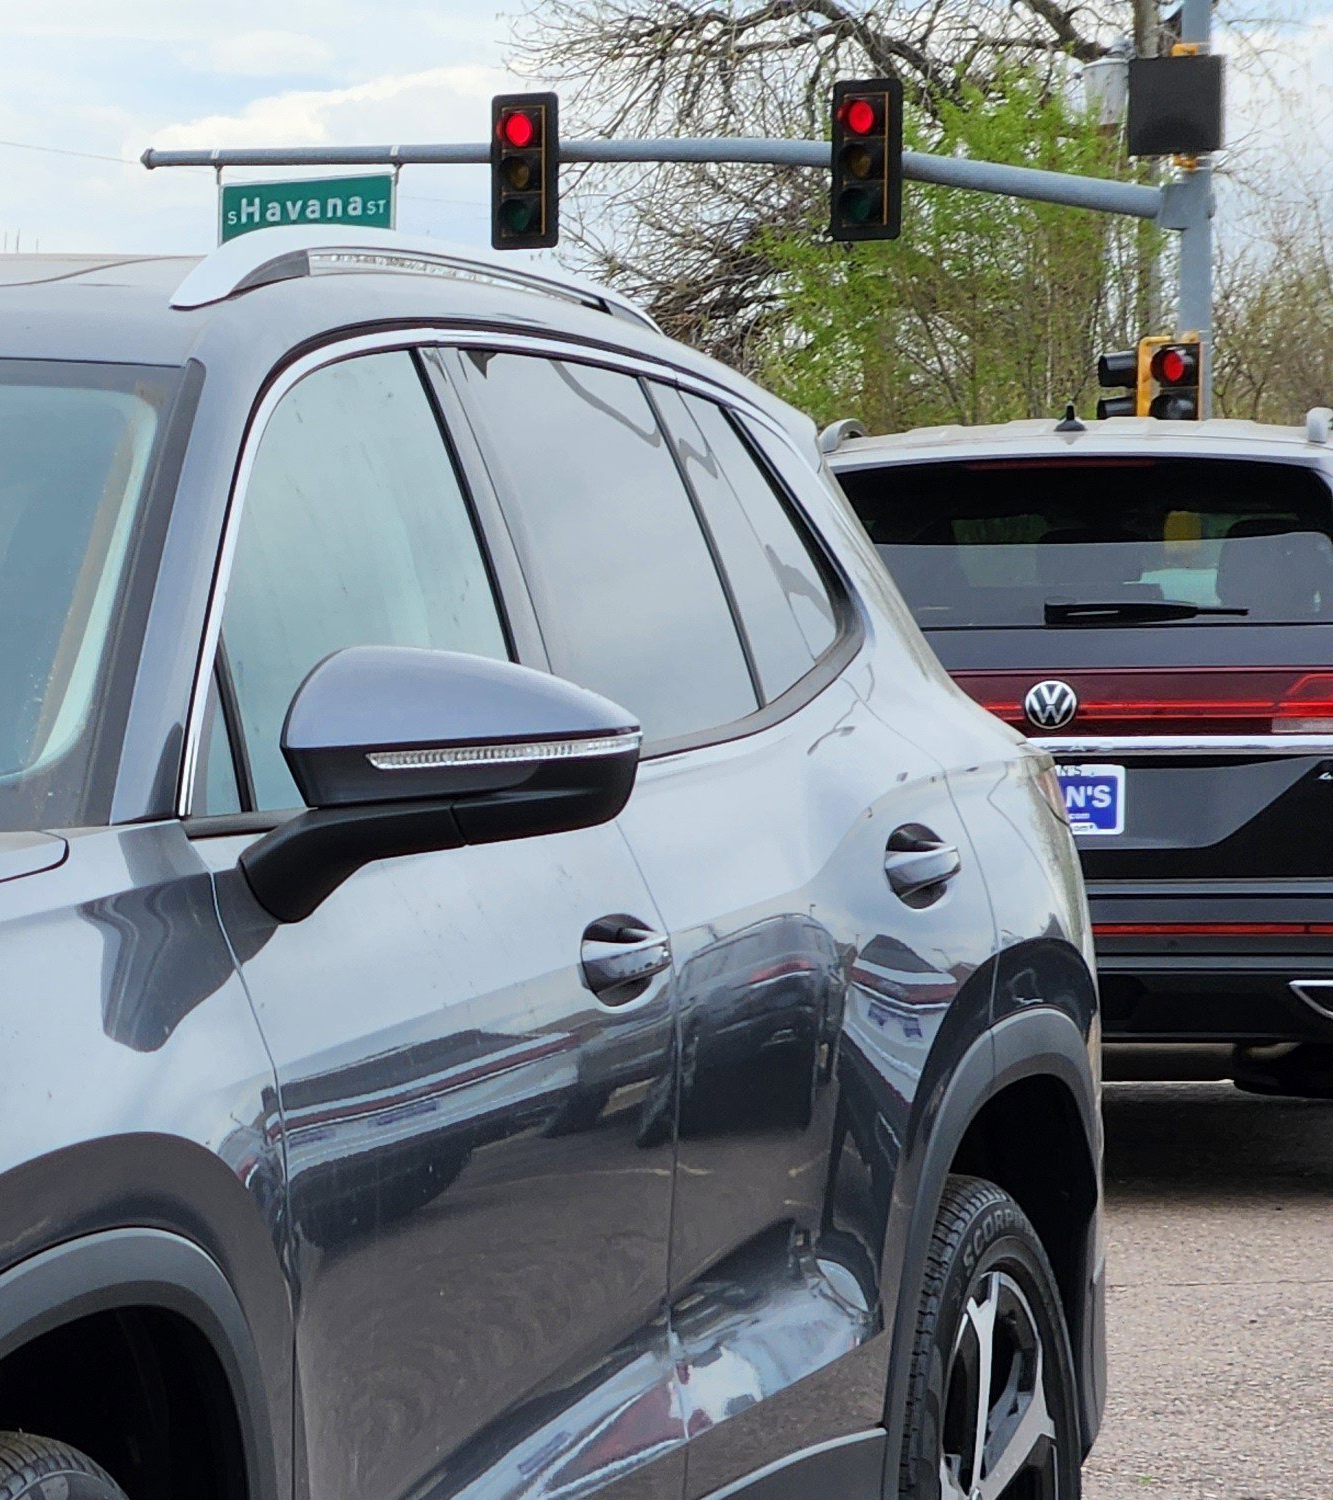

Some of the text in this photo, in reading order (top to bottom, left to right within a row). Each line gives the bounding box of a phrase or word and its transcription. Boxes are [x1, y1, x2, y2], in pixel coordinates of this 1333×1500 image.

[227, 195, 386, 225] S Havana ST
